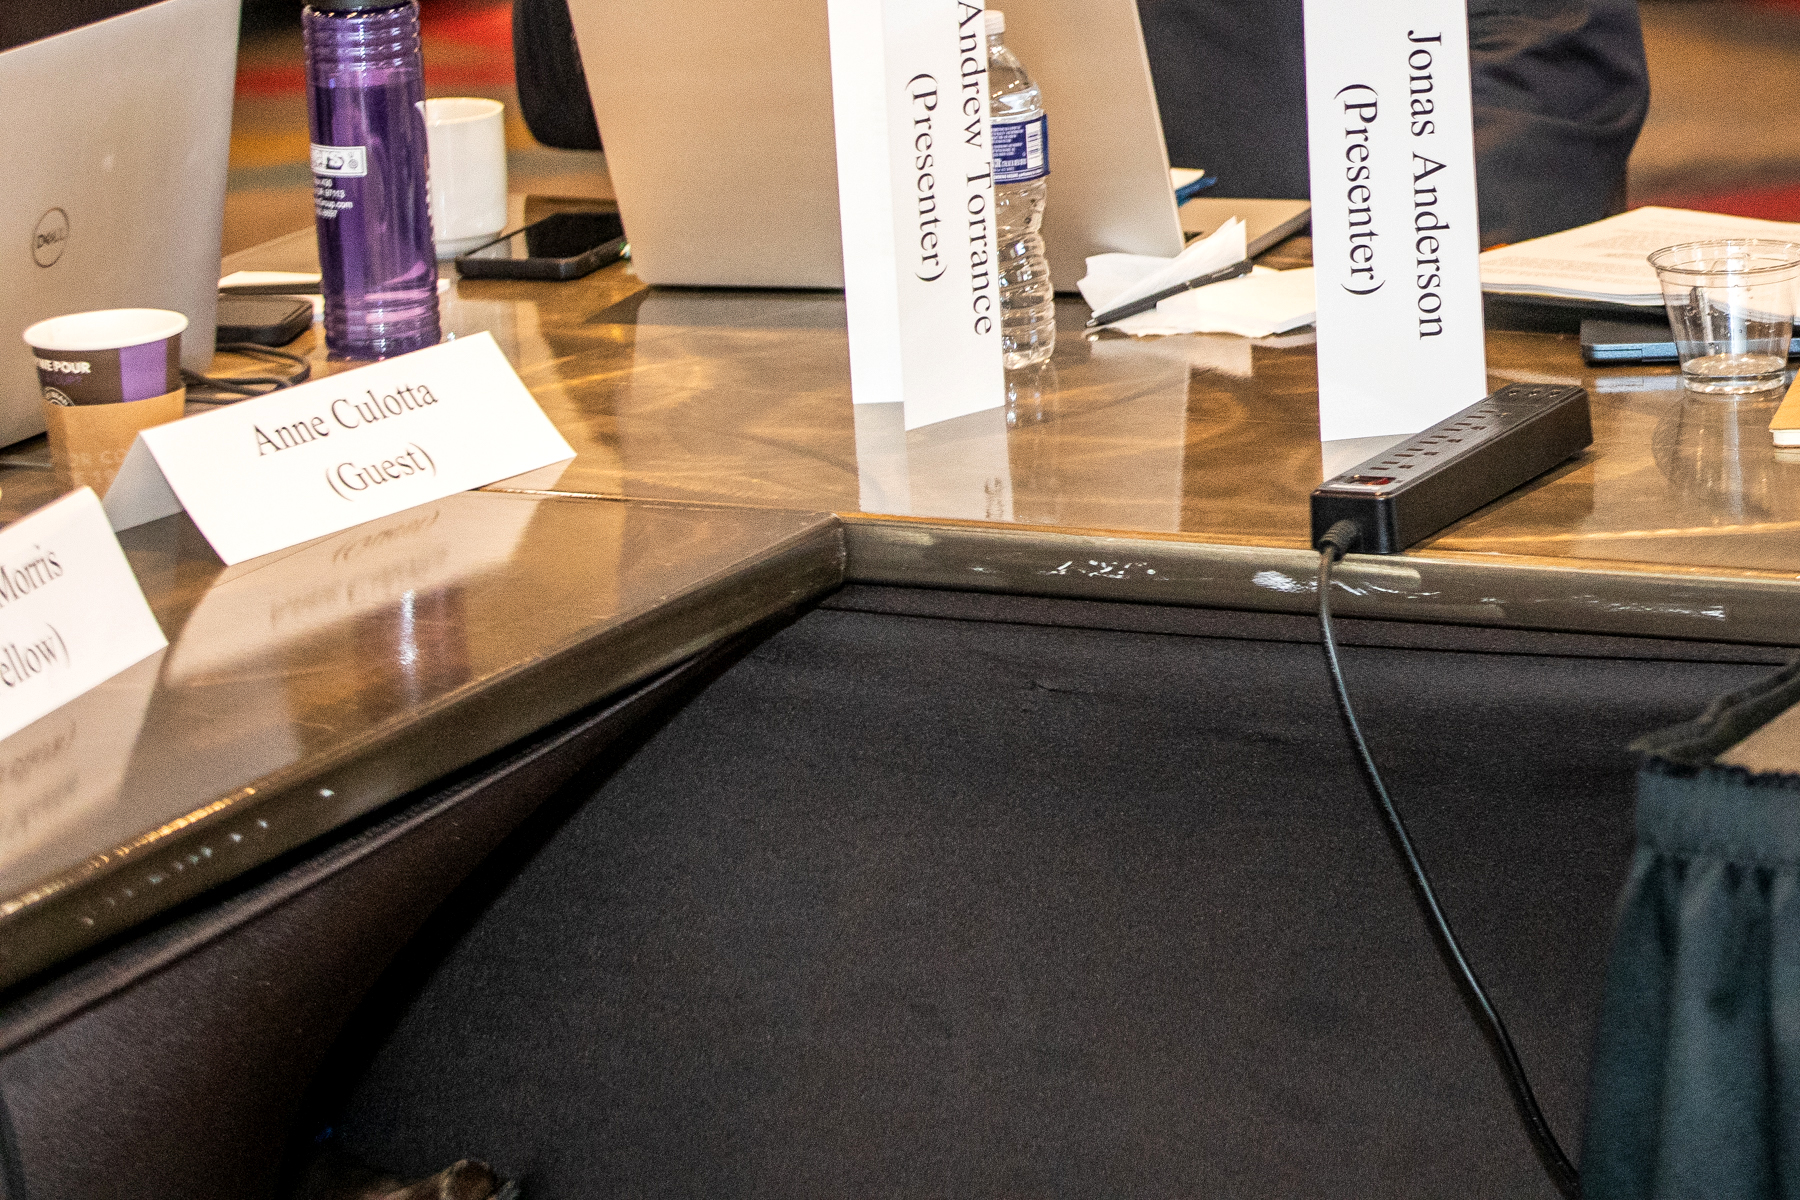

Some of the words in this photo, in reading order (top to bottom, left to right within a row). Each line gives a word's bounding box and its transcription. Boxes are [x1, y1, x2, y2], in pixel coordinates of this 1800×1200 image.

[1407, 29, 1442, 137] Jonas
[905, 72, 948, 283] (Presenter)
[1333, 83, 1386, 296] (Presenter)
[966, 160, 995, 337] Torrance
[1412, 150, 1451, 341] Anderson
[54, 360, 91, 374] POUR
[253, 415, 330, 456] Anne
[331, 383, 438, 430] Culotta
[325, 442, 436, 501] (Guest)
[0, 622, 71, 688] ellow)
